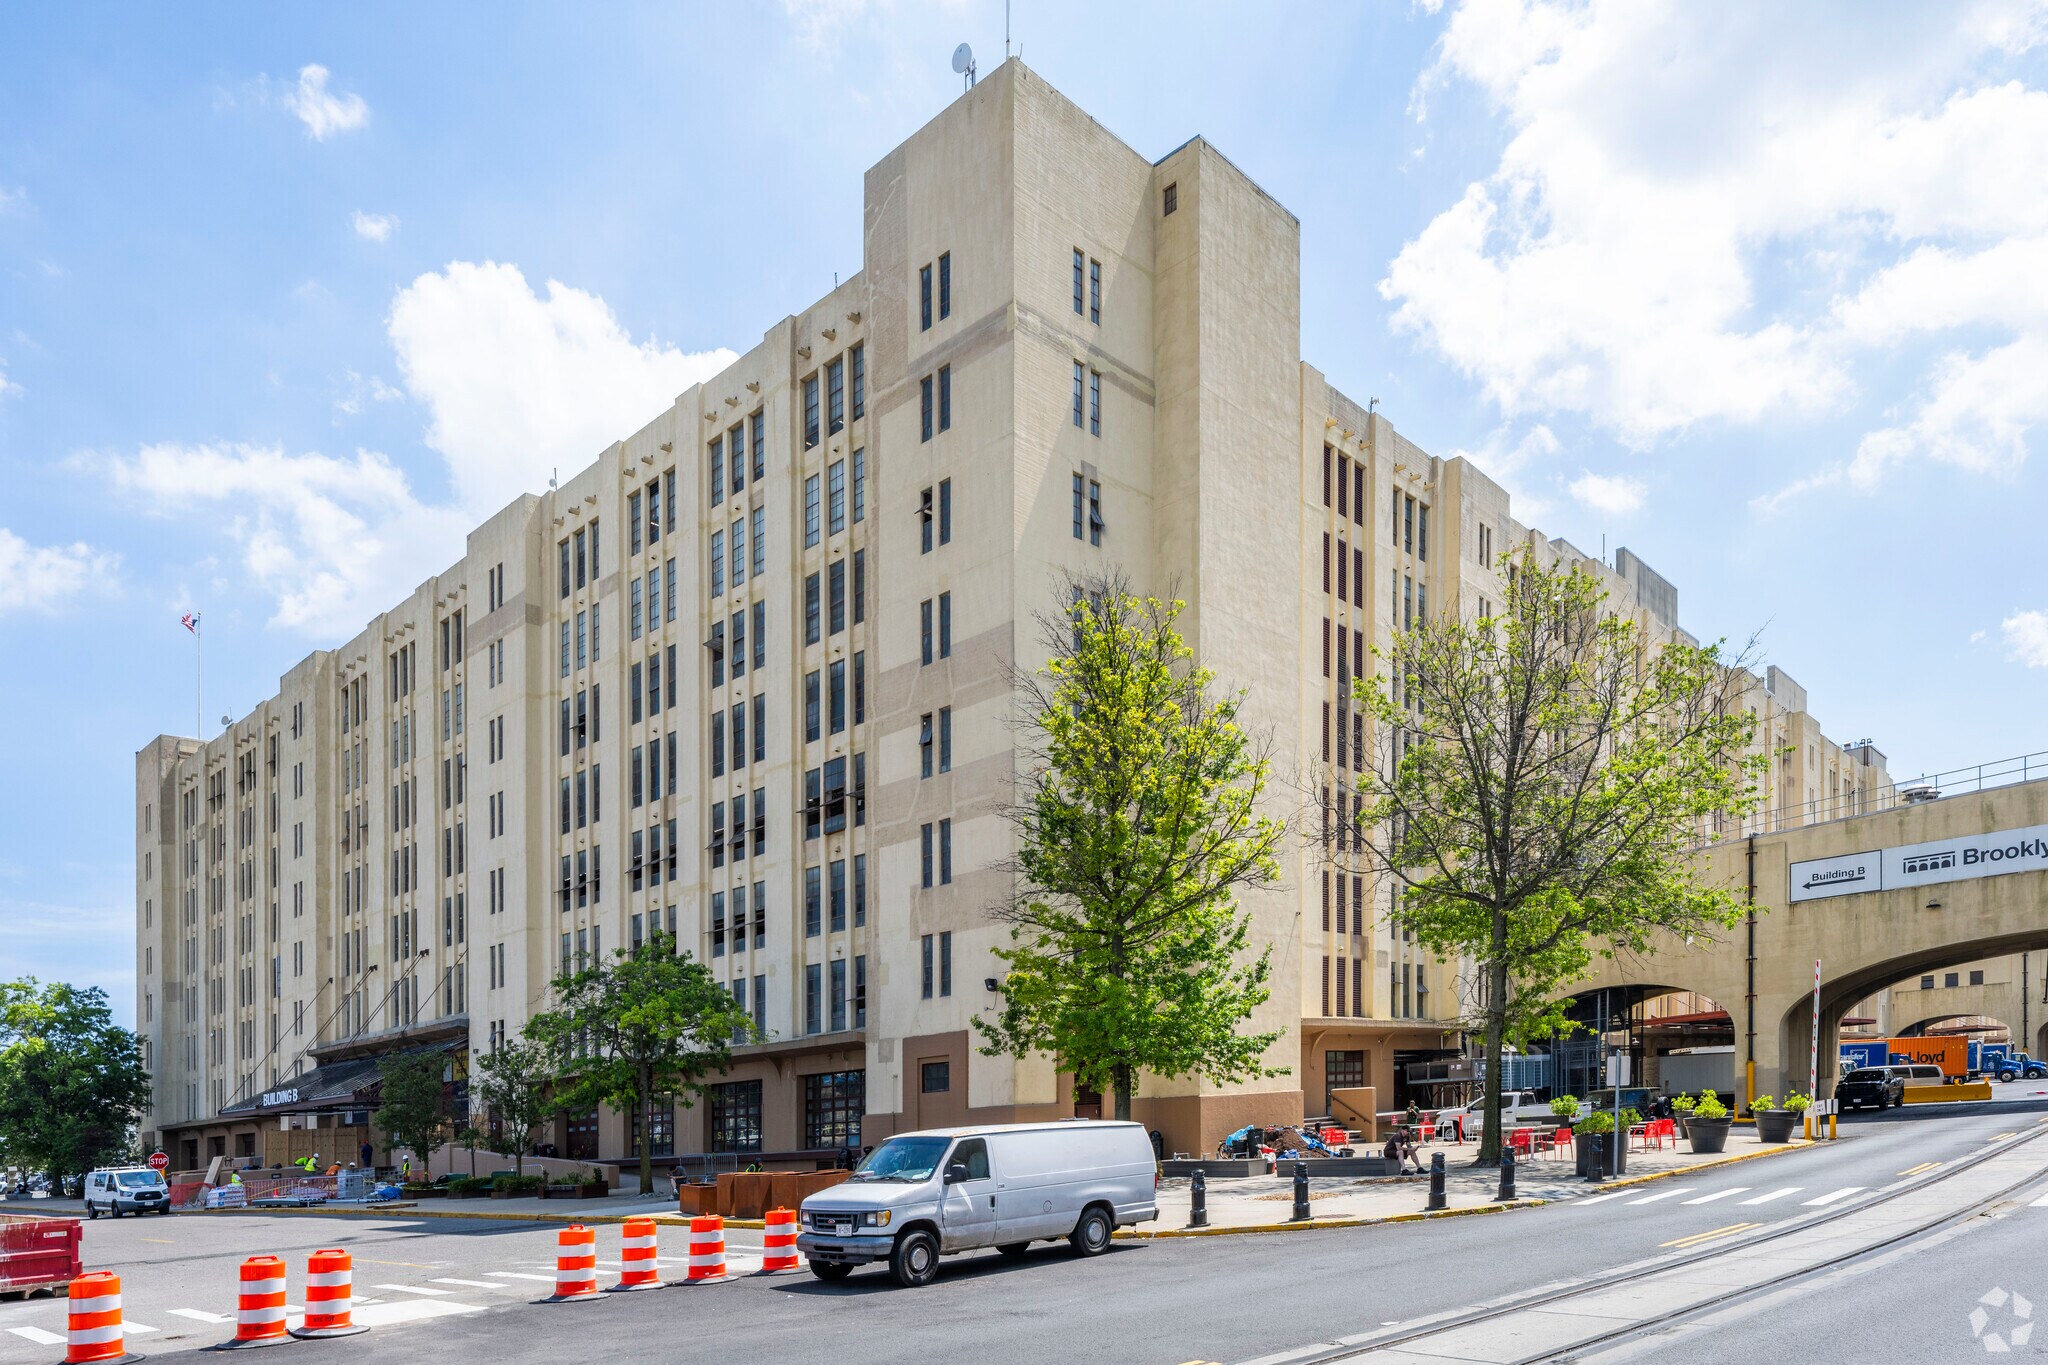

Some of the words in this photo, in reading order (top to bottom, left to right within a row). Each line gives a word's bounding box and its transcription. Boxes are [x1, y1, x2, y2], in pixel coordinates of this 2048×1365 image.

[1963, 838, 2048, 865] Brookly
[1812, 869, 1854, 881] Building
[1857, 866, 1865, 875] B
[263, 1090, 291, 1106] BUILDING
[292, 1088, 298, 1102] B
[150, 1157, 168, 1165] STOP
